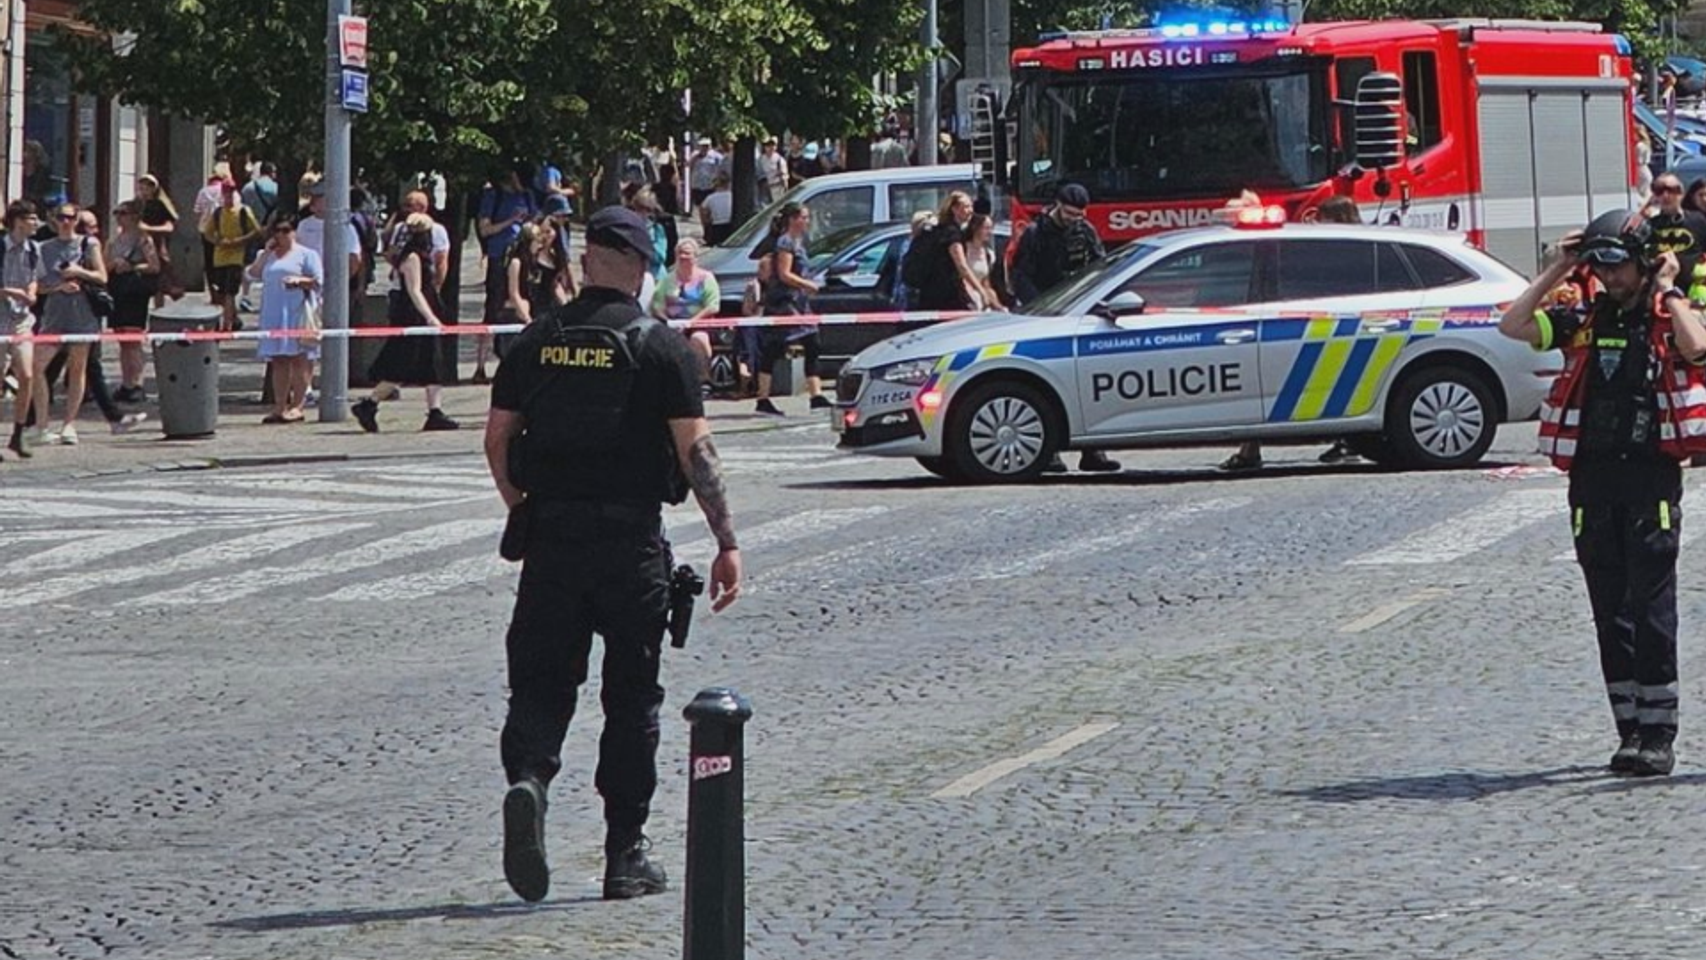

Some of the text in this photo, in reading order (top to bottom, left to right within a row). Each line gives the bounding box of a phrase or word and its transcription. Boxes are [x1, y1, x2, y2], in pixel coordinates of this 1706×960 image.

[1108, 208, 1212, 230] SCANIA
[540, 346, 614, 367] POLICIE
[1092, 363, 1242, 402] POLICIE
